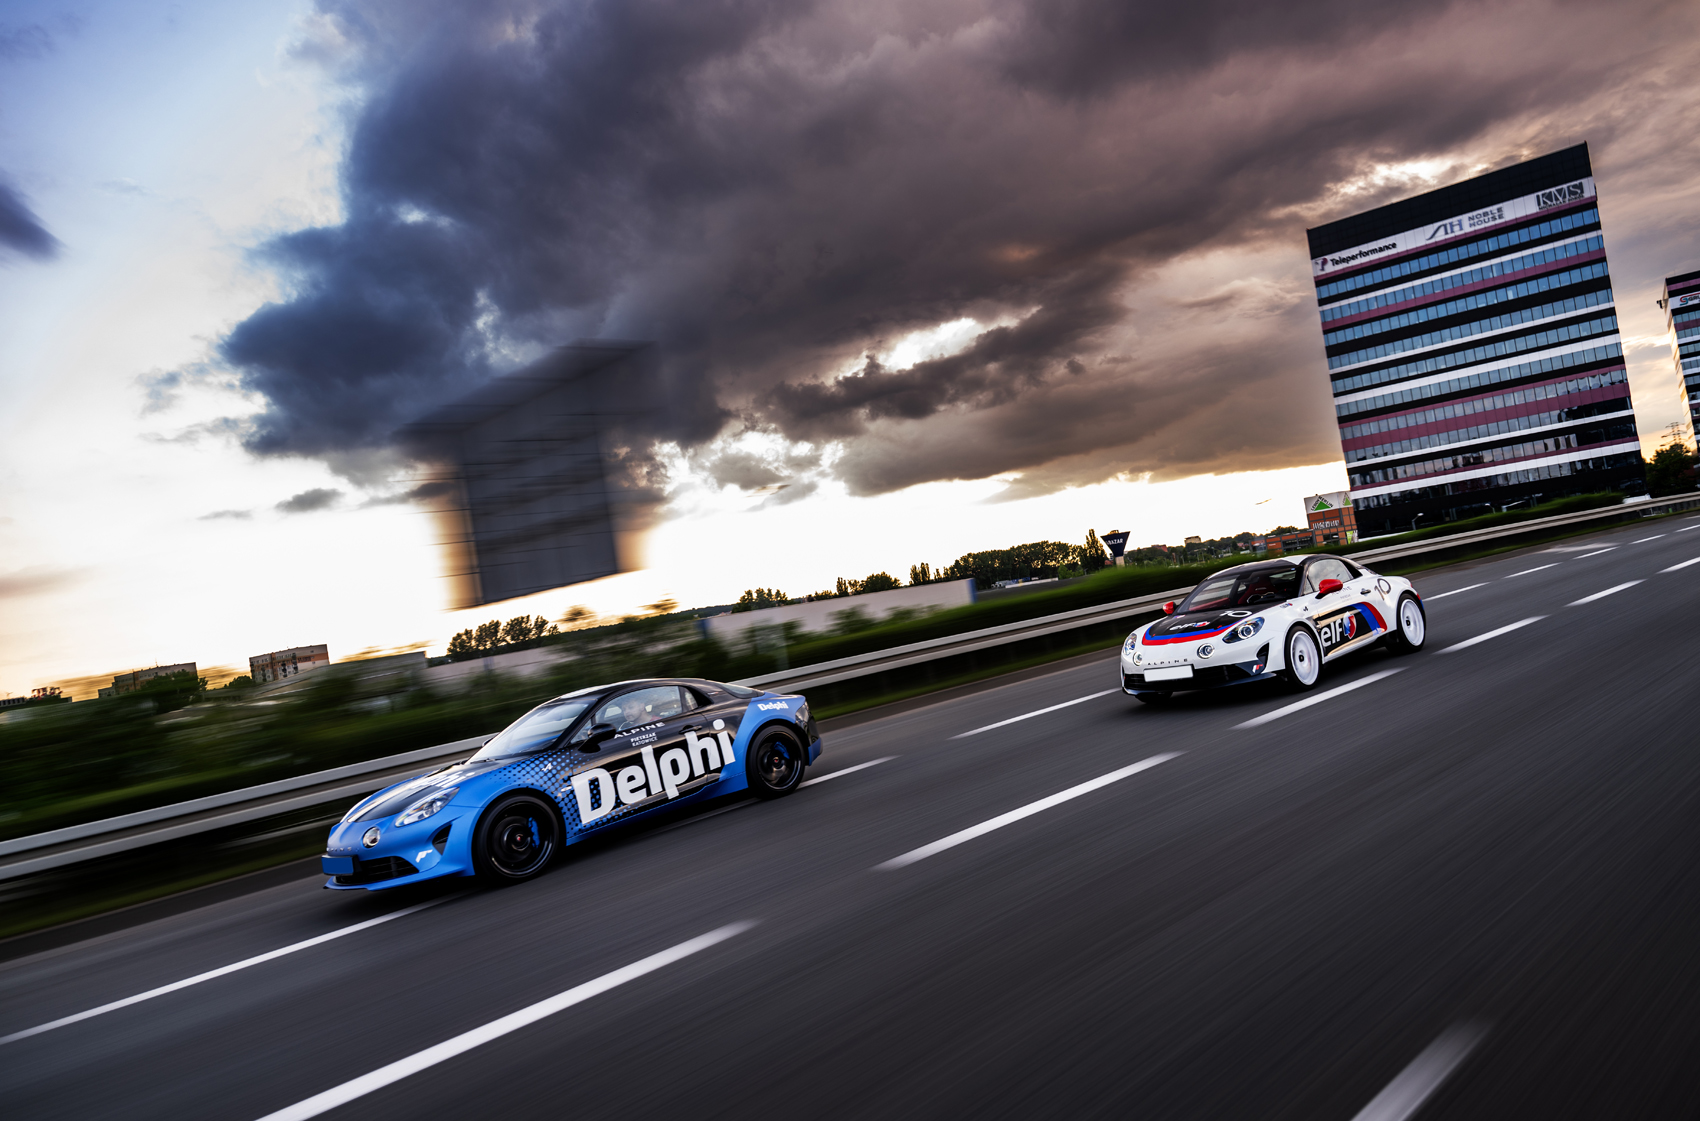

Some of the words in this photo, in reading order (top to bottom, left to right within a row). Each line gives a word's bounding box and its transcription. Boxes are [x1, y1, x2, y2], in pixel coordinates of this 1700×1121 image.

[1536, 181, 1585, 206] KMS
[1468, 206, 1503, 221] NOBLE
[1469, 213, 1505, 228] HOUSE
[1330, 242, 1397, 266] Teleperformance
[1321, 618, 1343, 648] elf
[1147, 658, 1188, 666] ALPINE
[757, 701, 789, 711] Delphi
[613, 721, 666, 739] ALPINE
[571, 718, 736, 825] Delphi
